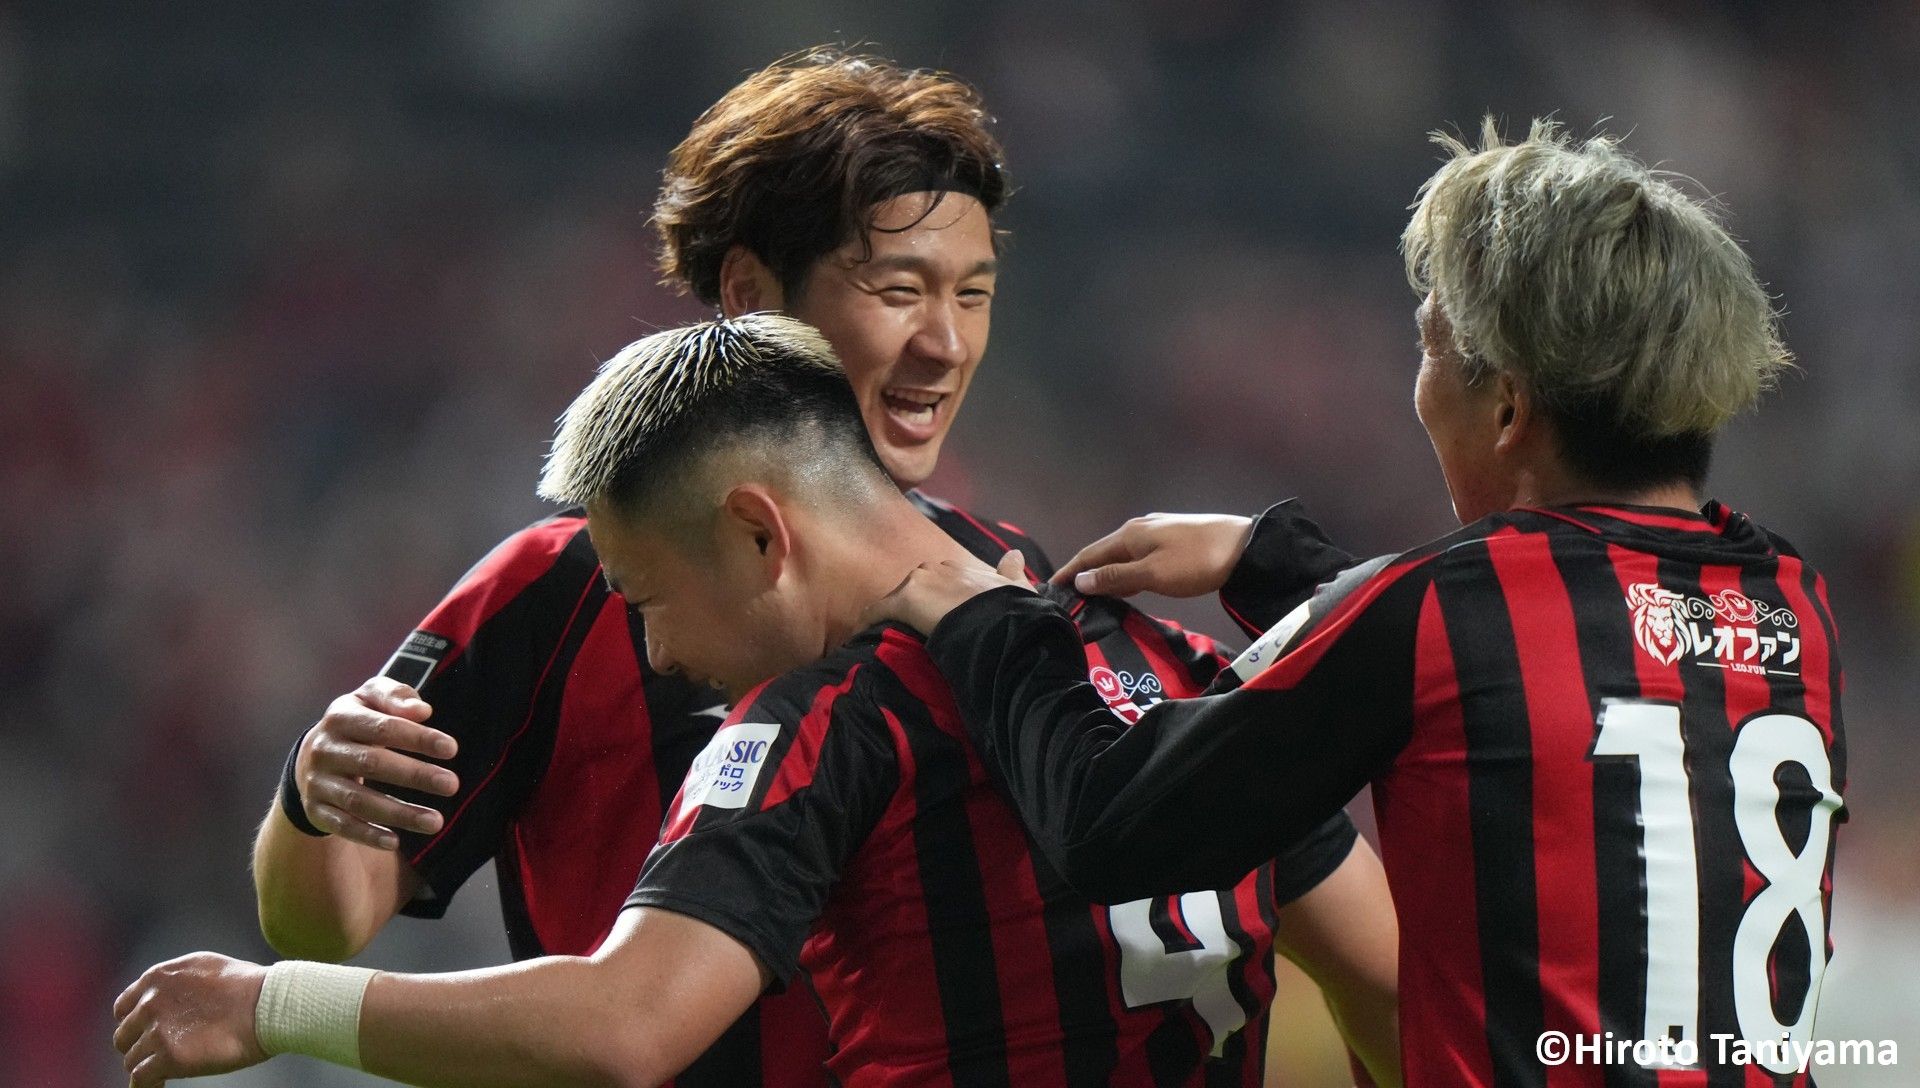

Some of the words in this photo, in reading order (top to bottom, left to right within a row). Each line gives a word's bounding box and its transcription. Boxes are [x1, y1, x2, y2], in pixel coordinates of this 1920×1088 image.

[1690, 621, 1800, 665] レオファン
[1593, 703, 1843, 1074] 18
